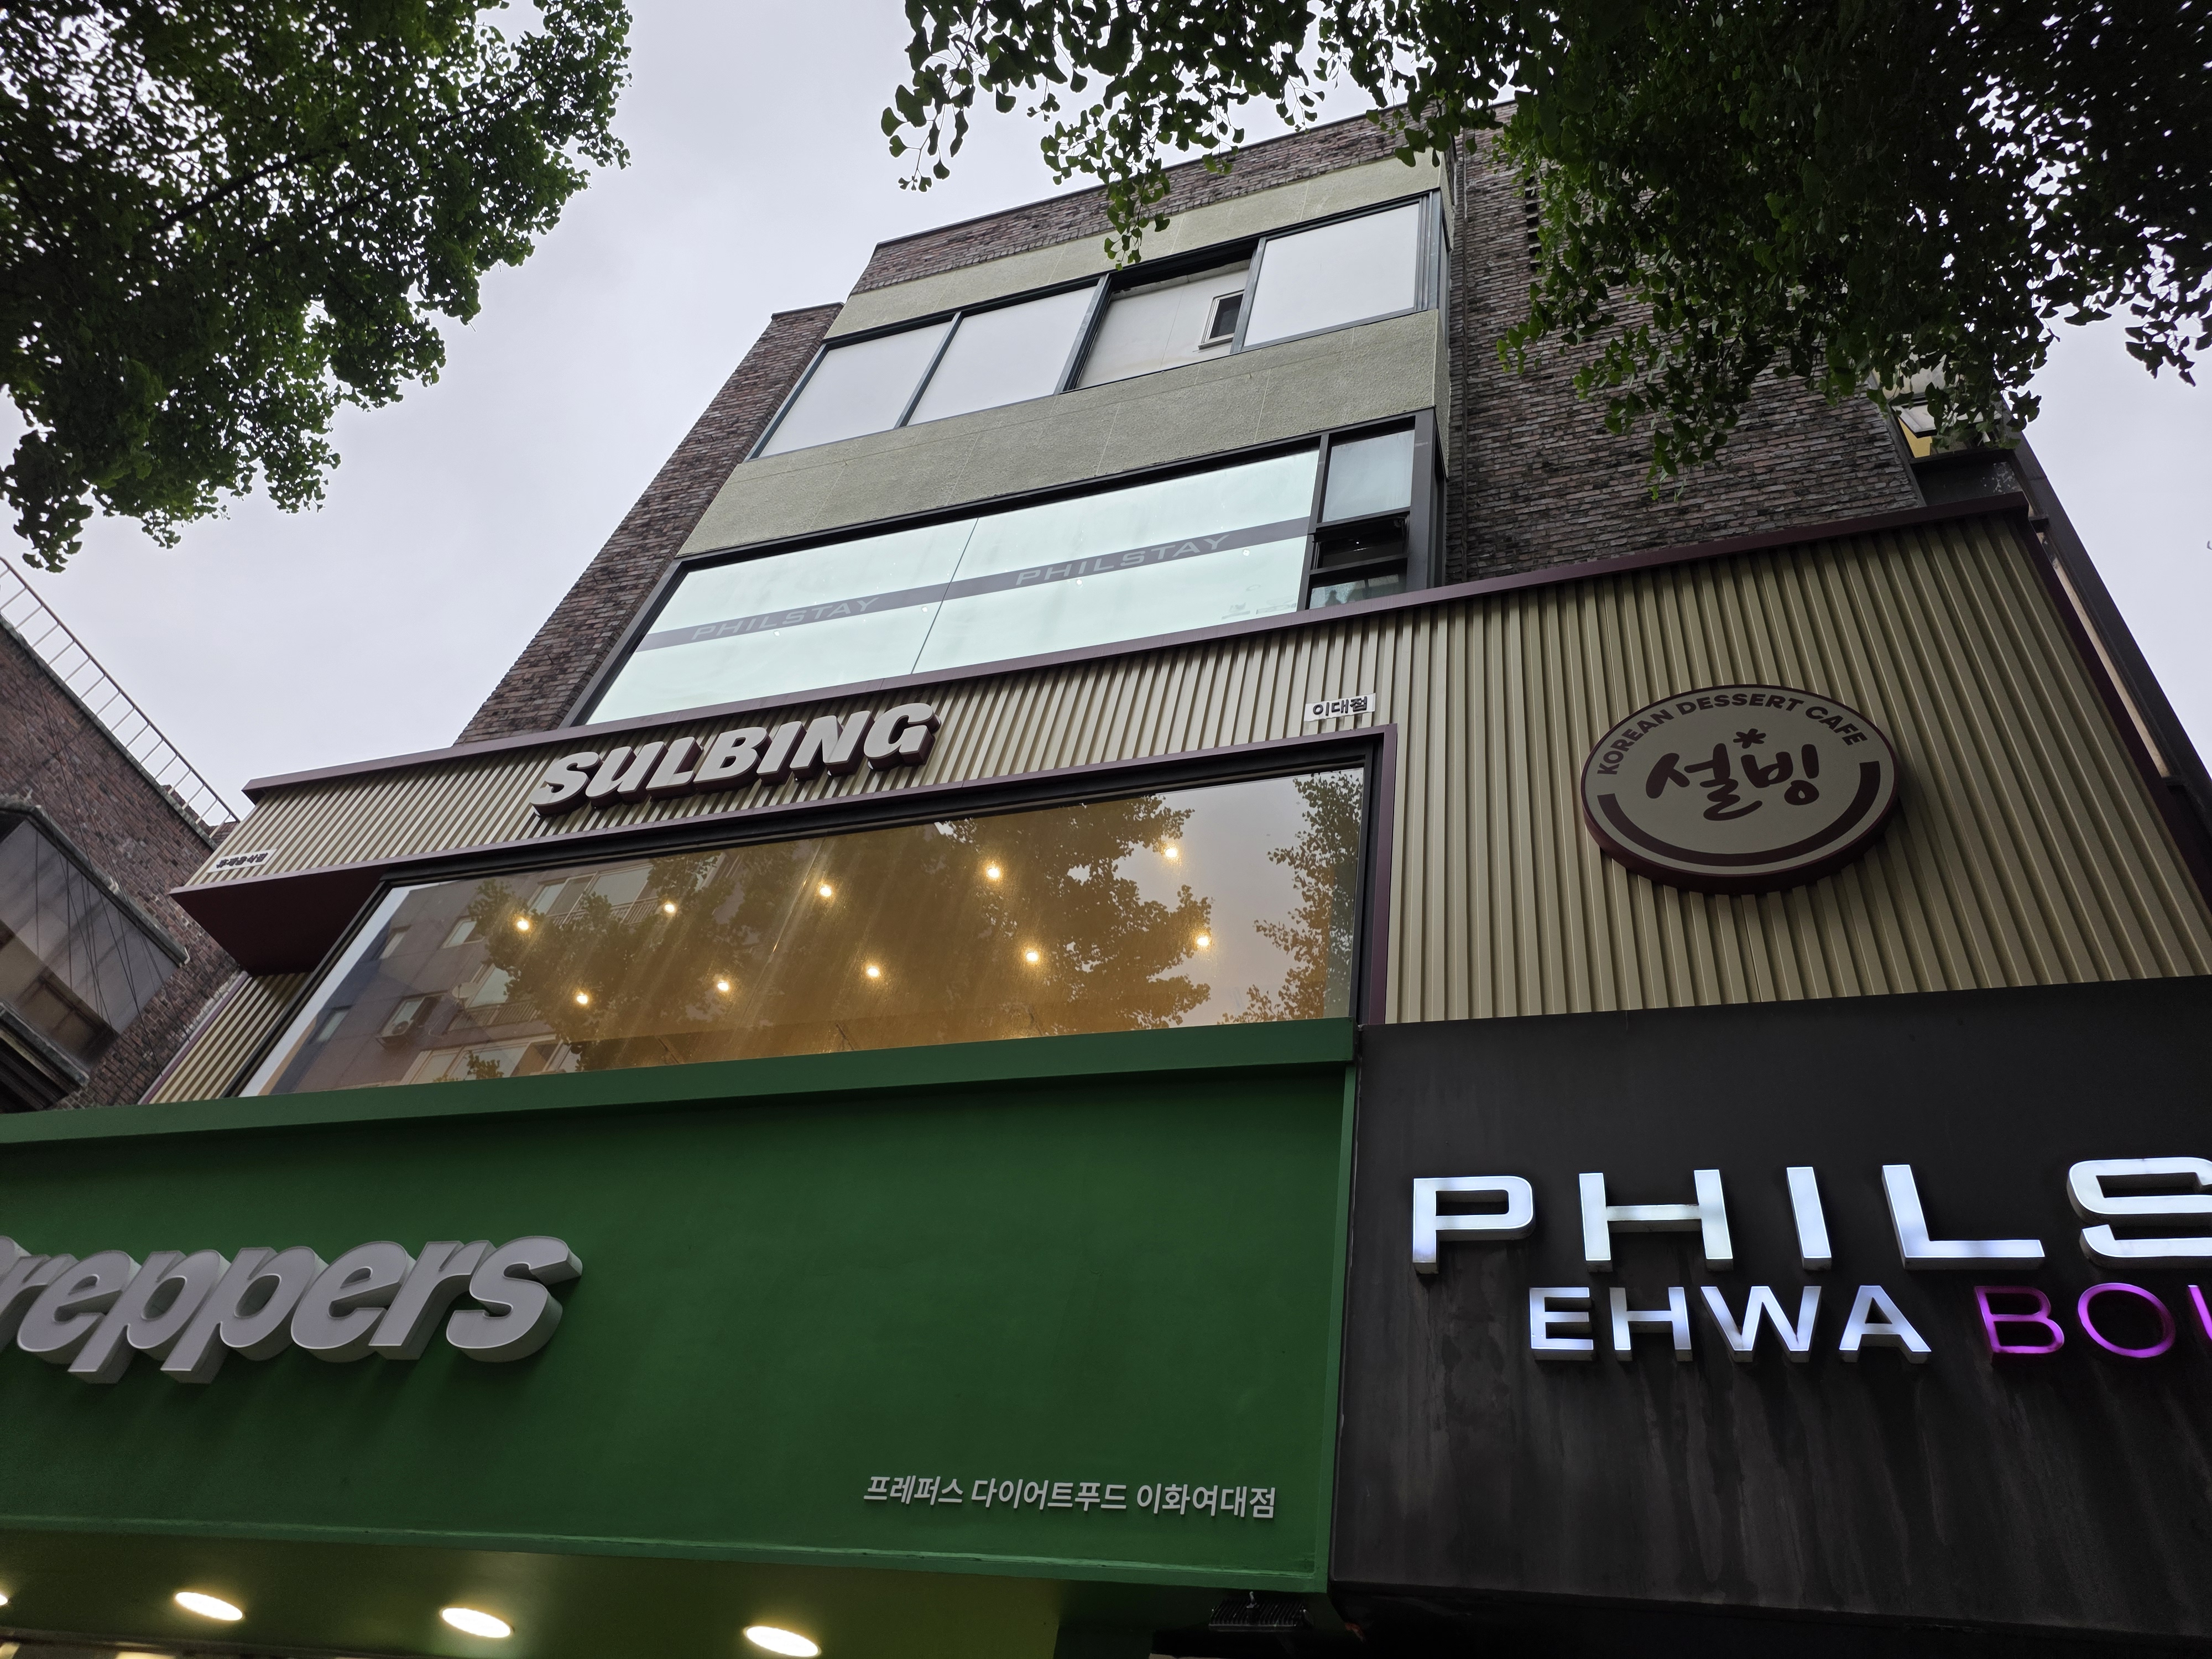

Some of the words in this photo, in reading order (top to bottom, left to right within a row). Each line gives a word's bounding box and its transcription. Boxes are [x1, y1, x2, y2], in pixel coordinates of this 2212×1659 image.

[1015, 534, 1230, 585] PHILSTAY
[691, 597, 879, 640] PHILSTAY
[1312, 696, 1368, 716] 이대점
[1597, 709, 1674, 775] KOREAN
[1675, 693, 1804, 716] DESSERT
[1805, 706, 1868, 746] CAFE
[529, 703, 941, 816] SULBING
[1646, 743, 1819, 821] 설빙
[1412, 1157, 2212, 1273] PHILS
[0, 1235, 582, 1384] reppers
[1529, 1285, 1932, 1364] EHWA
[864, 1475, 964, 1506] 프레퍼스
[971, 1478, 1128, 1511] 다이어트푸드
[1136, 1483, 1276, 1519] 이화여대점
